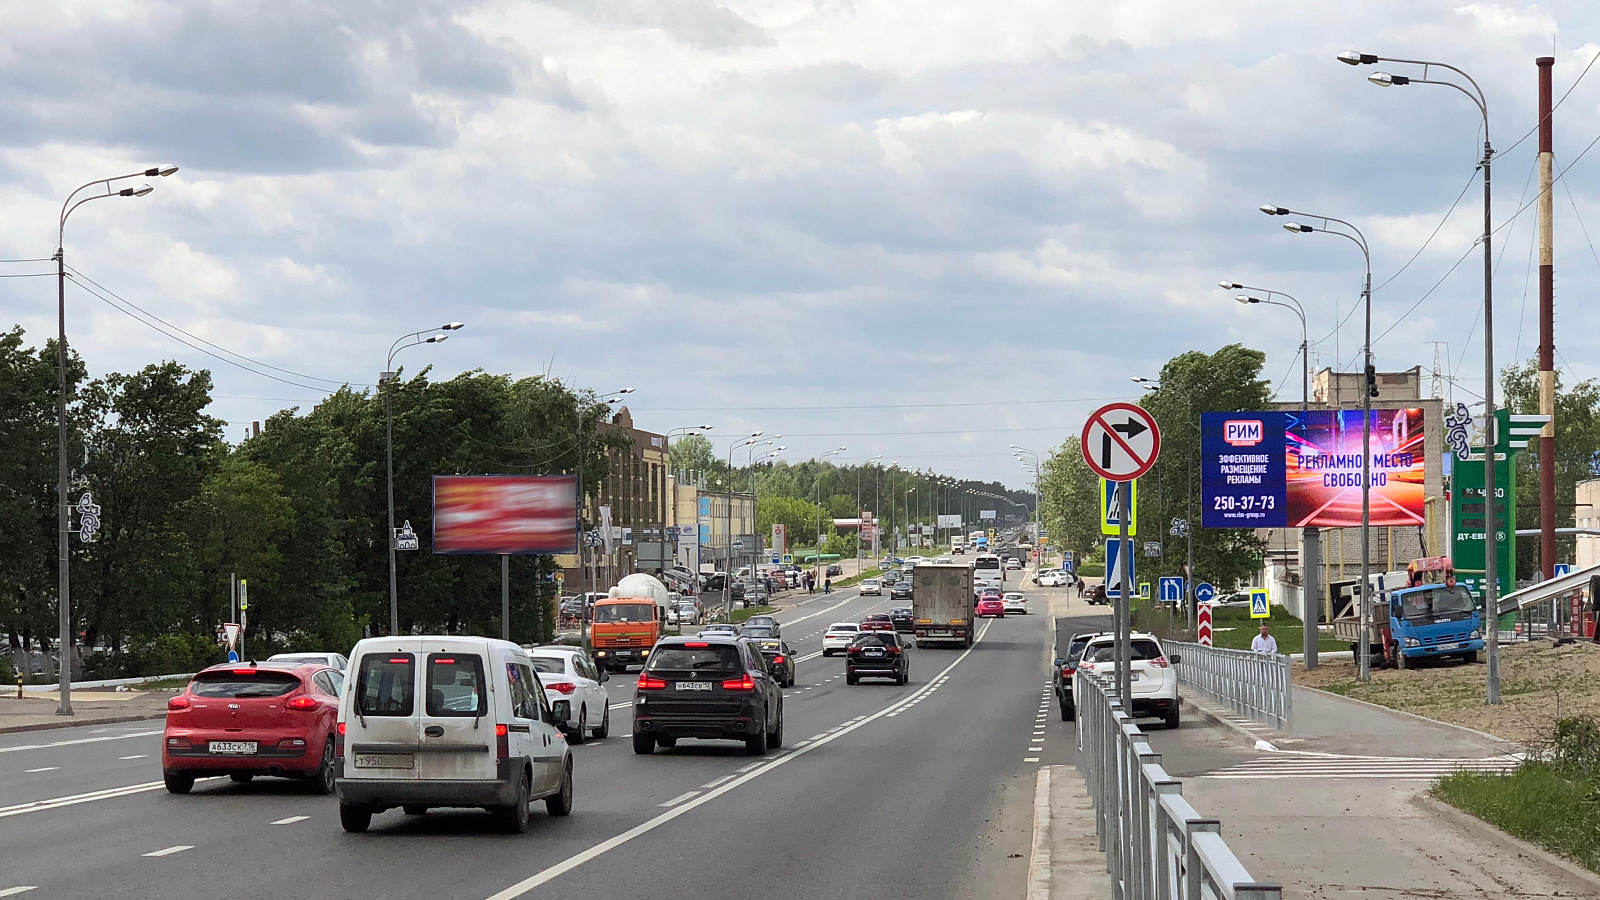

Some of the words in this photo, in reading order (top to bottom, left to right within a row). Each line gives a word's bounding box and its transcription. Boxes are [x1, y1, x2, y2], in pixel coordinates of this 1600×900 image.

[1228, 424, 1259, 439] РИМ
[1218, 454, 1270, 463] ЭФФЕКТИВНОЕ
[1298, 454, 1367, 469] РЕКЛАМНО
[1373, 453, 1413, 468] МЕСТО
[1220, 464, 1268, 474] РАЗМЕЩЕНИЕ
[1226, 475, 1262, 484] РЕКЛАМЫ
[1323, 472, 1387, 488] СВОБОНО
[1214, 496, 1275, 510] 250-37-73
